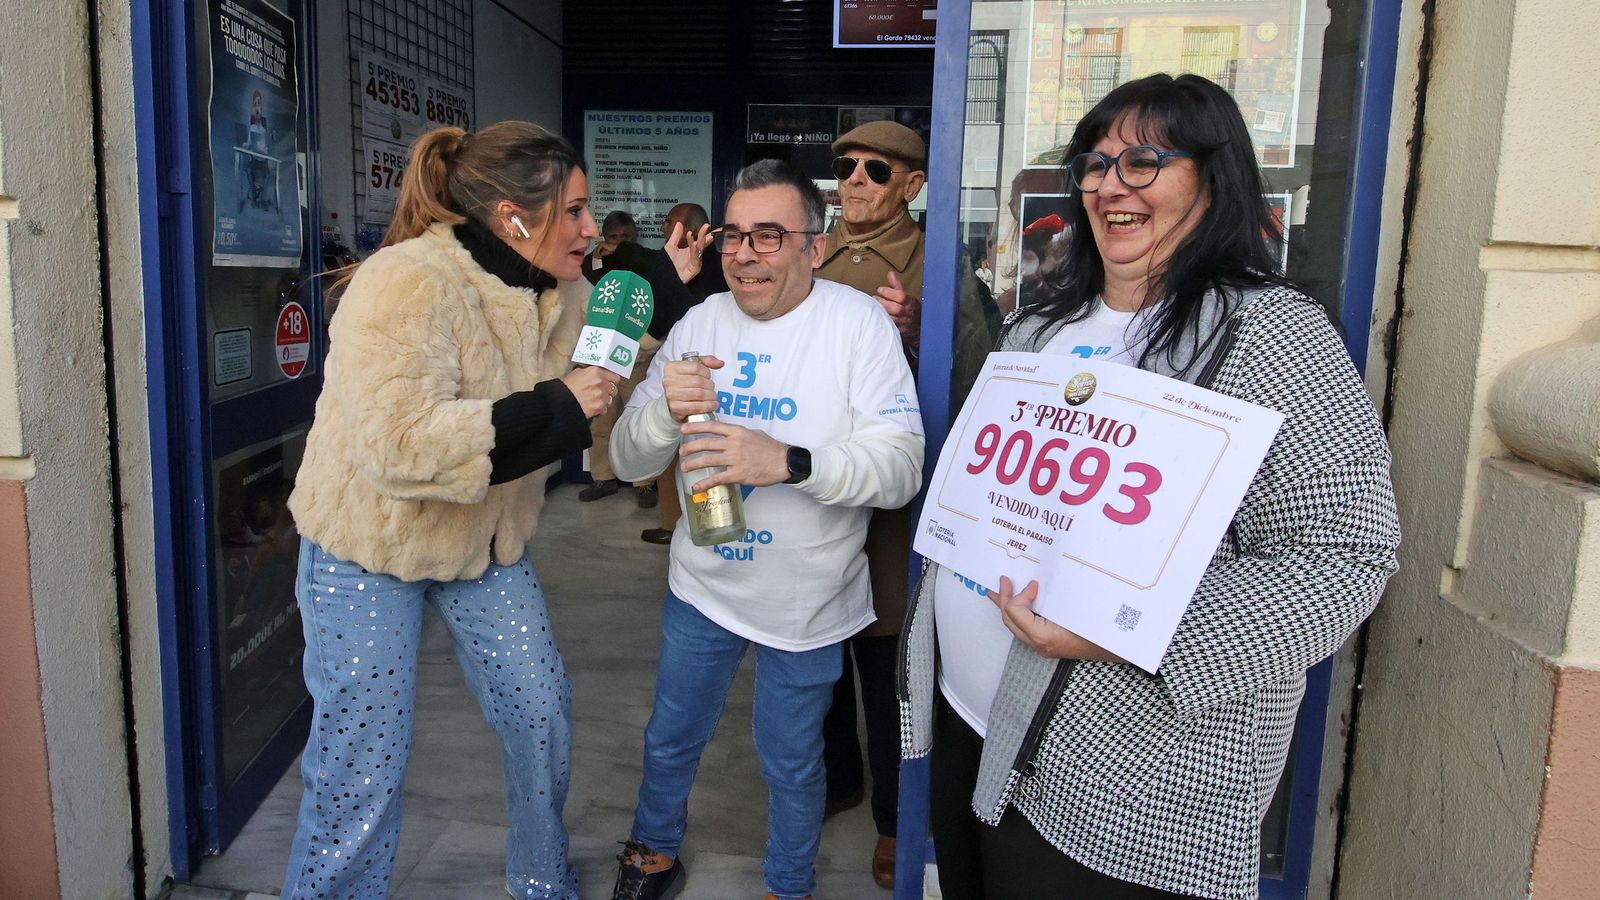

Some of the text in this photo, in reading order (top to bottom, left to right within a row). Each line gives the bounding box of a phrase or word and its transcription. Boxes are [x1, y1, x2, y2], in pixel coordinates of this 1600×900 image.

[220, 15, 230, 34] ES
[231, 20, 246, 42] UNA
[246, 29, 263, 51] COSA
[377, 65, 416, 92] PREMIO
[366, 77, 420, 116] 45353
[436, 90, 467, 111] PREMIO
[426, 99, 470, 133] 88979
[588, 114, 710, 124] NUESTROS PREMIOS
[598, 126, 699, 136] ÚLTIMOS 5 AÑOS
[767, 132, 791, 143] llegó
[804, 131, 833, 142] NIÑO!
[592, 306, 615, 314] CanalSur
[624, 312, 645, 328] CanalSur
[283, 311, 303, 335] +18
[614, 348, 630, 363] AD
[715, 390, 798, 421] REMIO
[879, 407, 902, 415] LOTERÍA
[1162, 392, 1242, 424] 22 de Diciembre
[1034, 404, 1137, 448] PREMIO
[966, 423, 1163, 525] 90693
[988, 491, 1076, 532] VENDIDO AQUÍ
[934, 531, 956, 547] NACIONAL
[992, 516, 1054, 546] LOTERIA EL PARAISO
[1006, 538, 1028, 552] JEREZ
